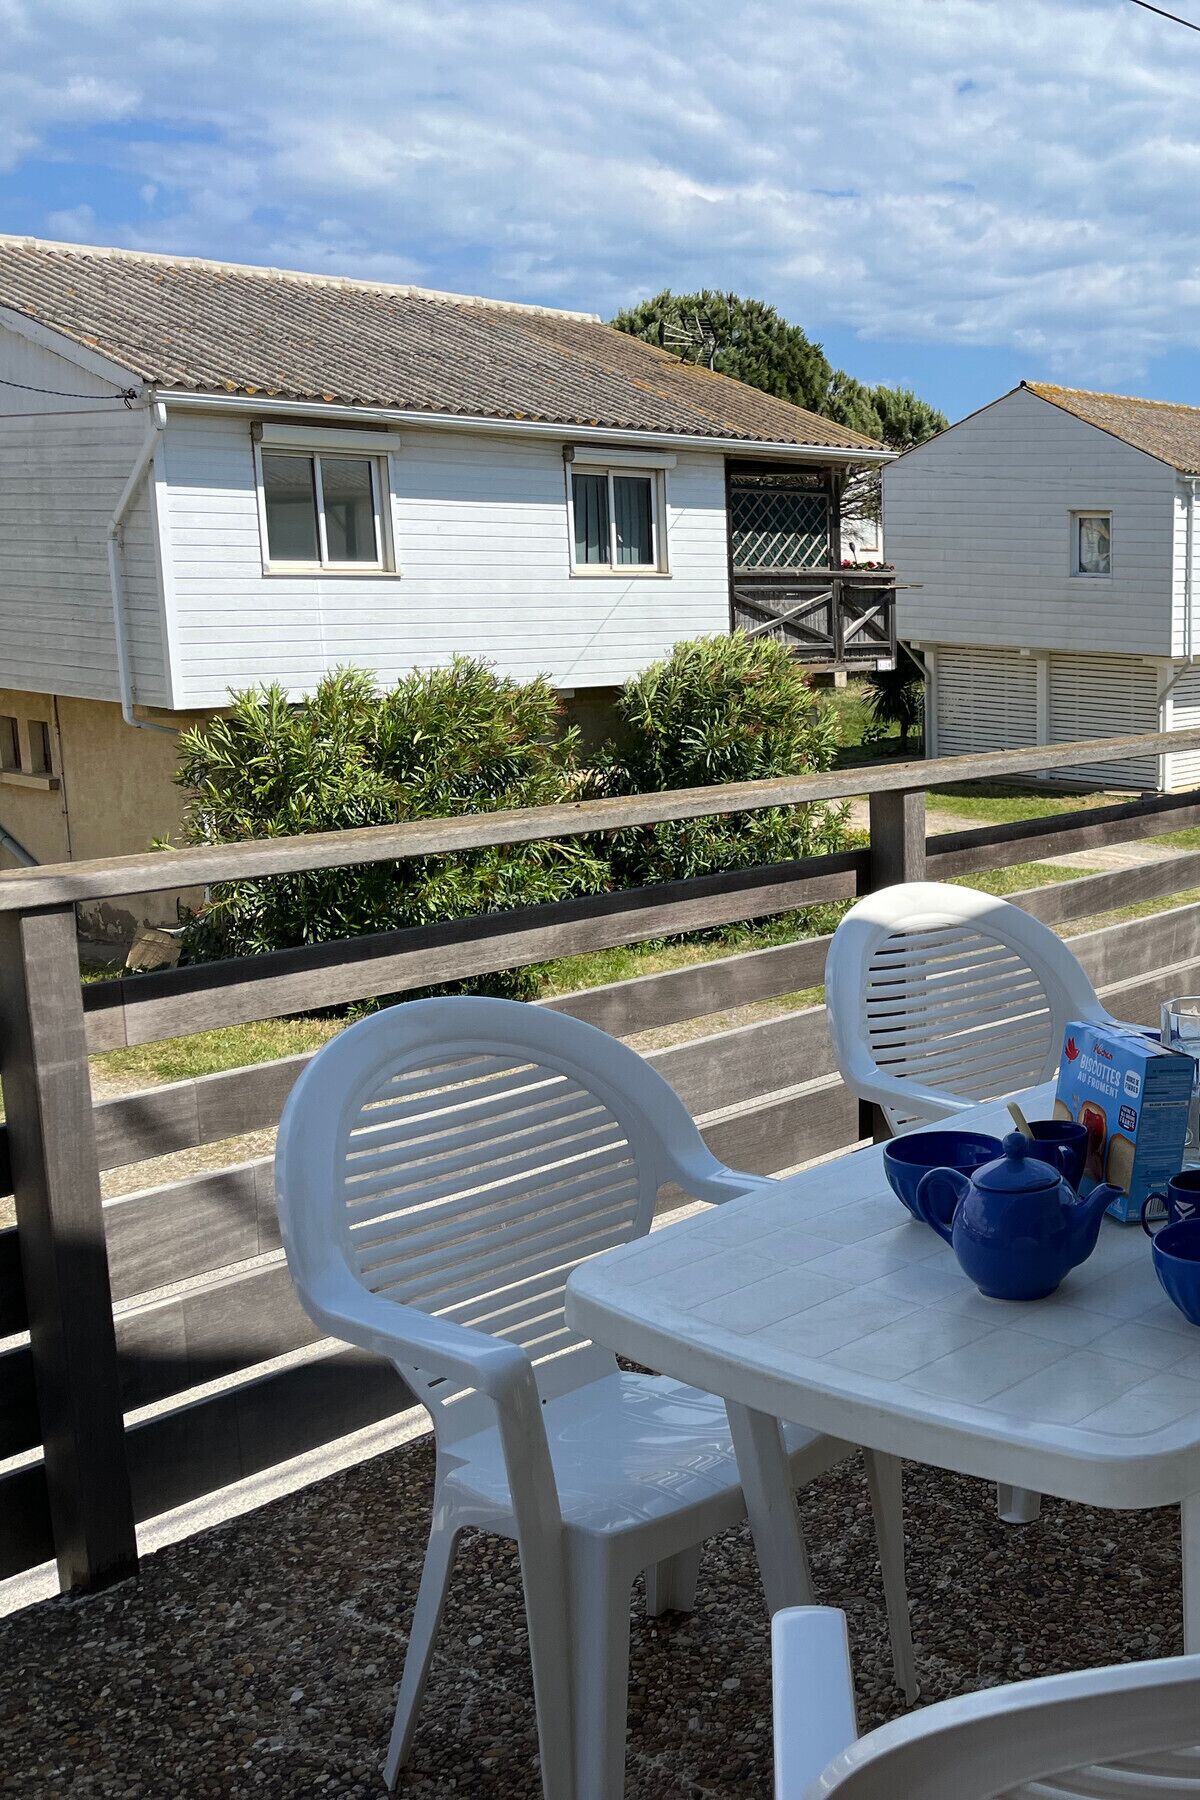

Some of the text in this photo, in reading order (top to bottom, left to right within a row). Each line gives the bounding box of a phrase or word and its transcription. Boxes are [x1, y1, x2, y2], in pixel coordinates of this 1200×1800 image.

[1080, 1054, 1121, 1087] BISCOTTES
[1077, 1071, 1119, 1098] AU FROMENT
[1119, 1115, 1135, 1130] FRANCE
